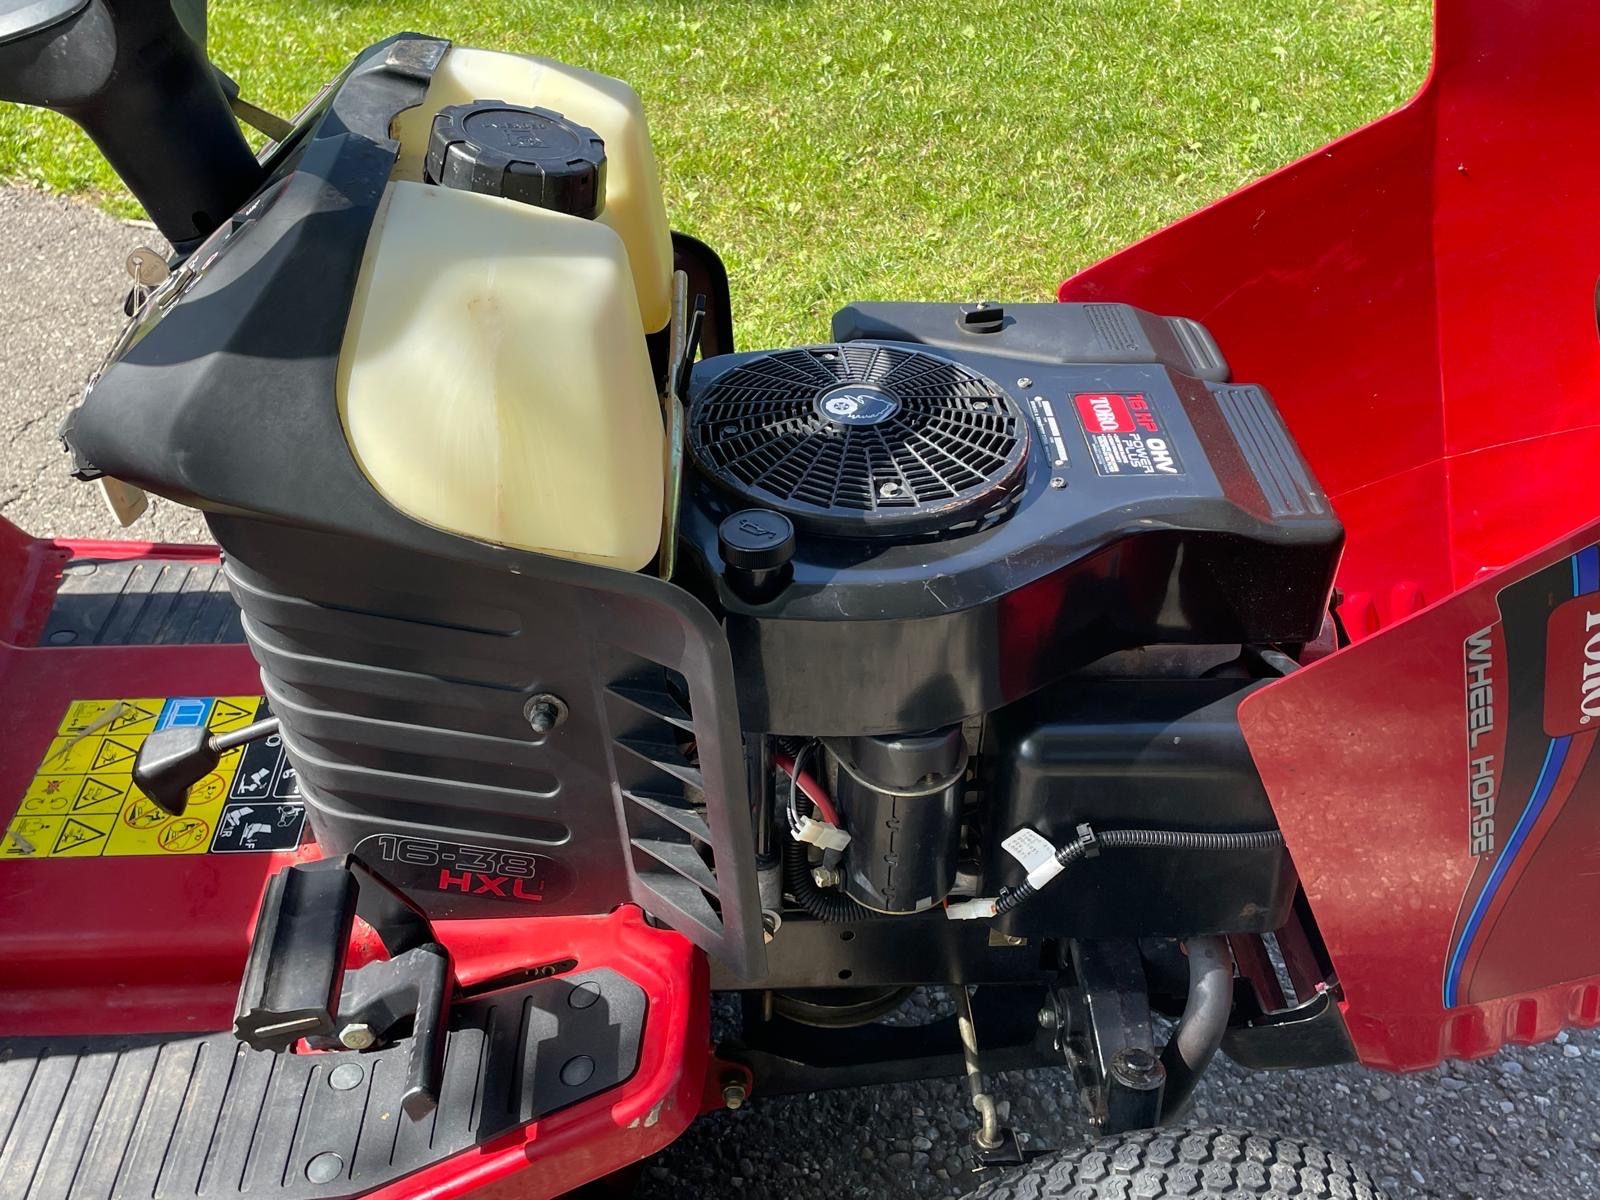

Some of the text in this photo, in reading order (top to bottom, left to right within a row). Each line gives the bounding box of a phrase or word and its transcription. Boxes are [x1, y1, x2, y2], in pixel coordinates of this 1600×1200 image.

[1089, 396, 1119, 431] TORO
[1135, 413, 1158, 432] HP
[1121, 439, 1142, 468] PLUS
[1128, 433, 1155, 474] POWER
[1146, 438, 1178, 474] OHV
[1467, 626, 1495, 855] WHEEL HORSE
[378, 836, 536, 879] 16-38
[438, 868, 543, 901] HXL
